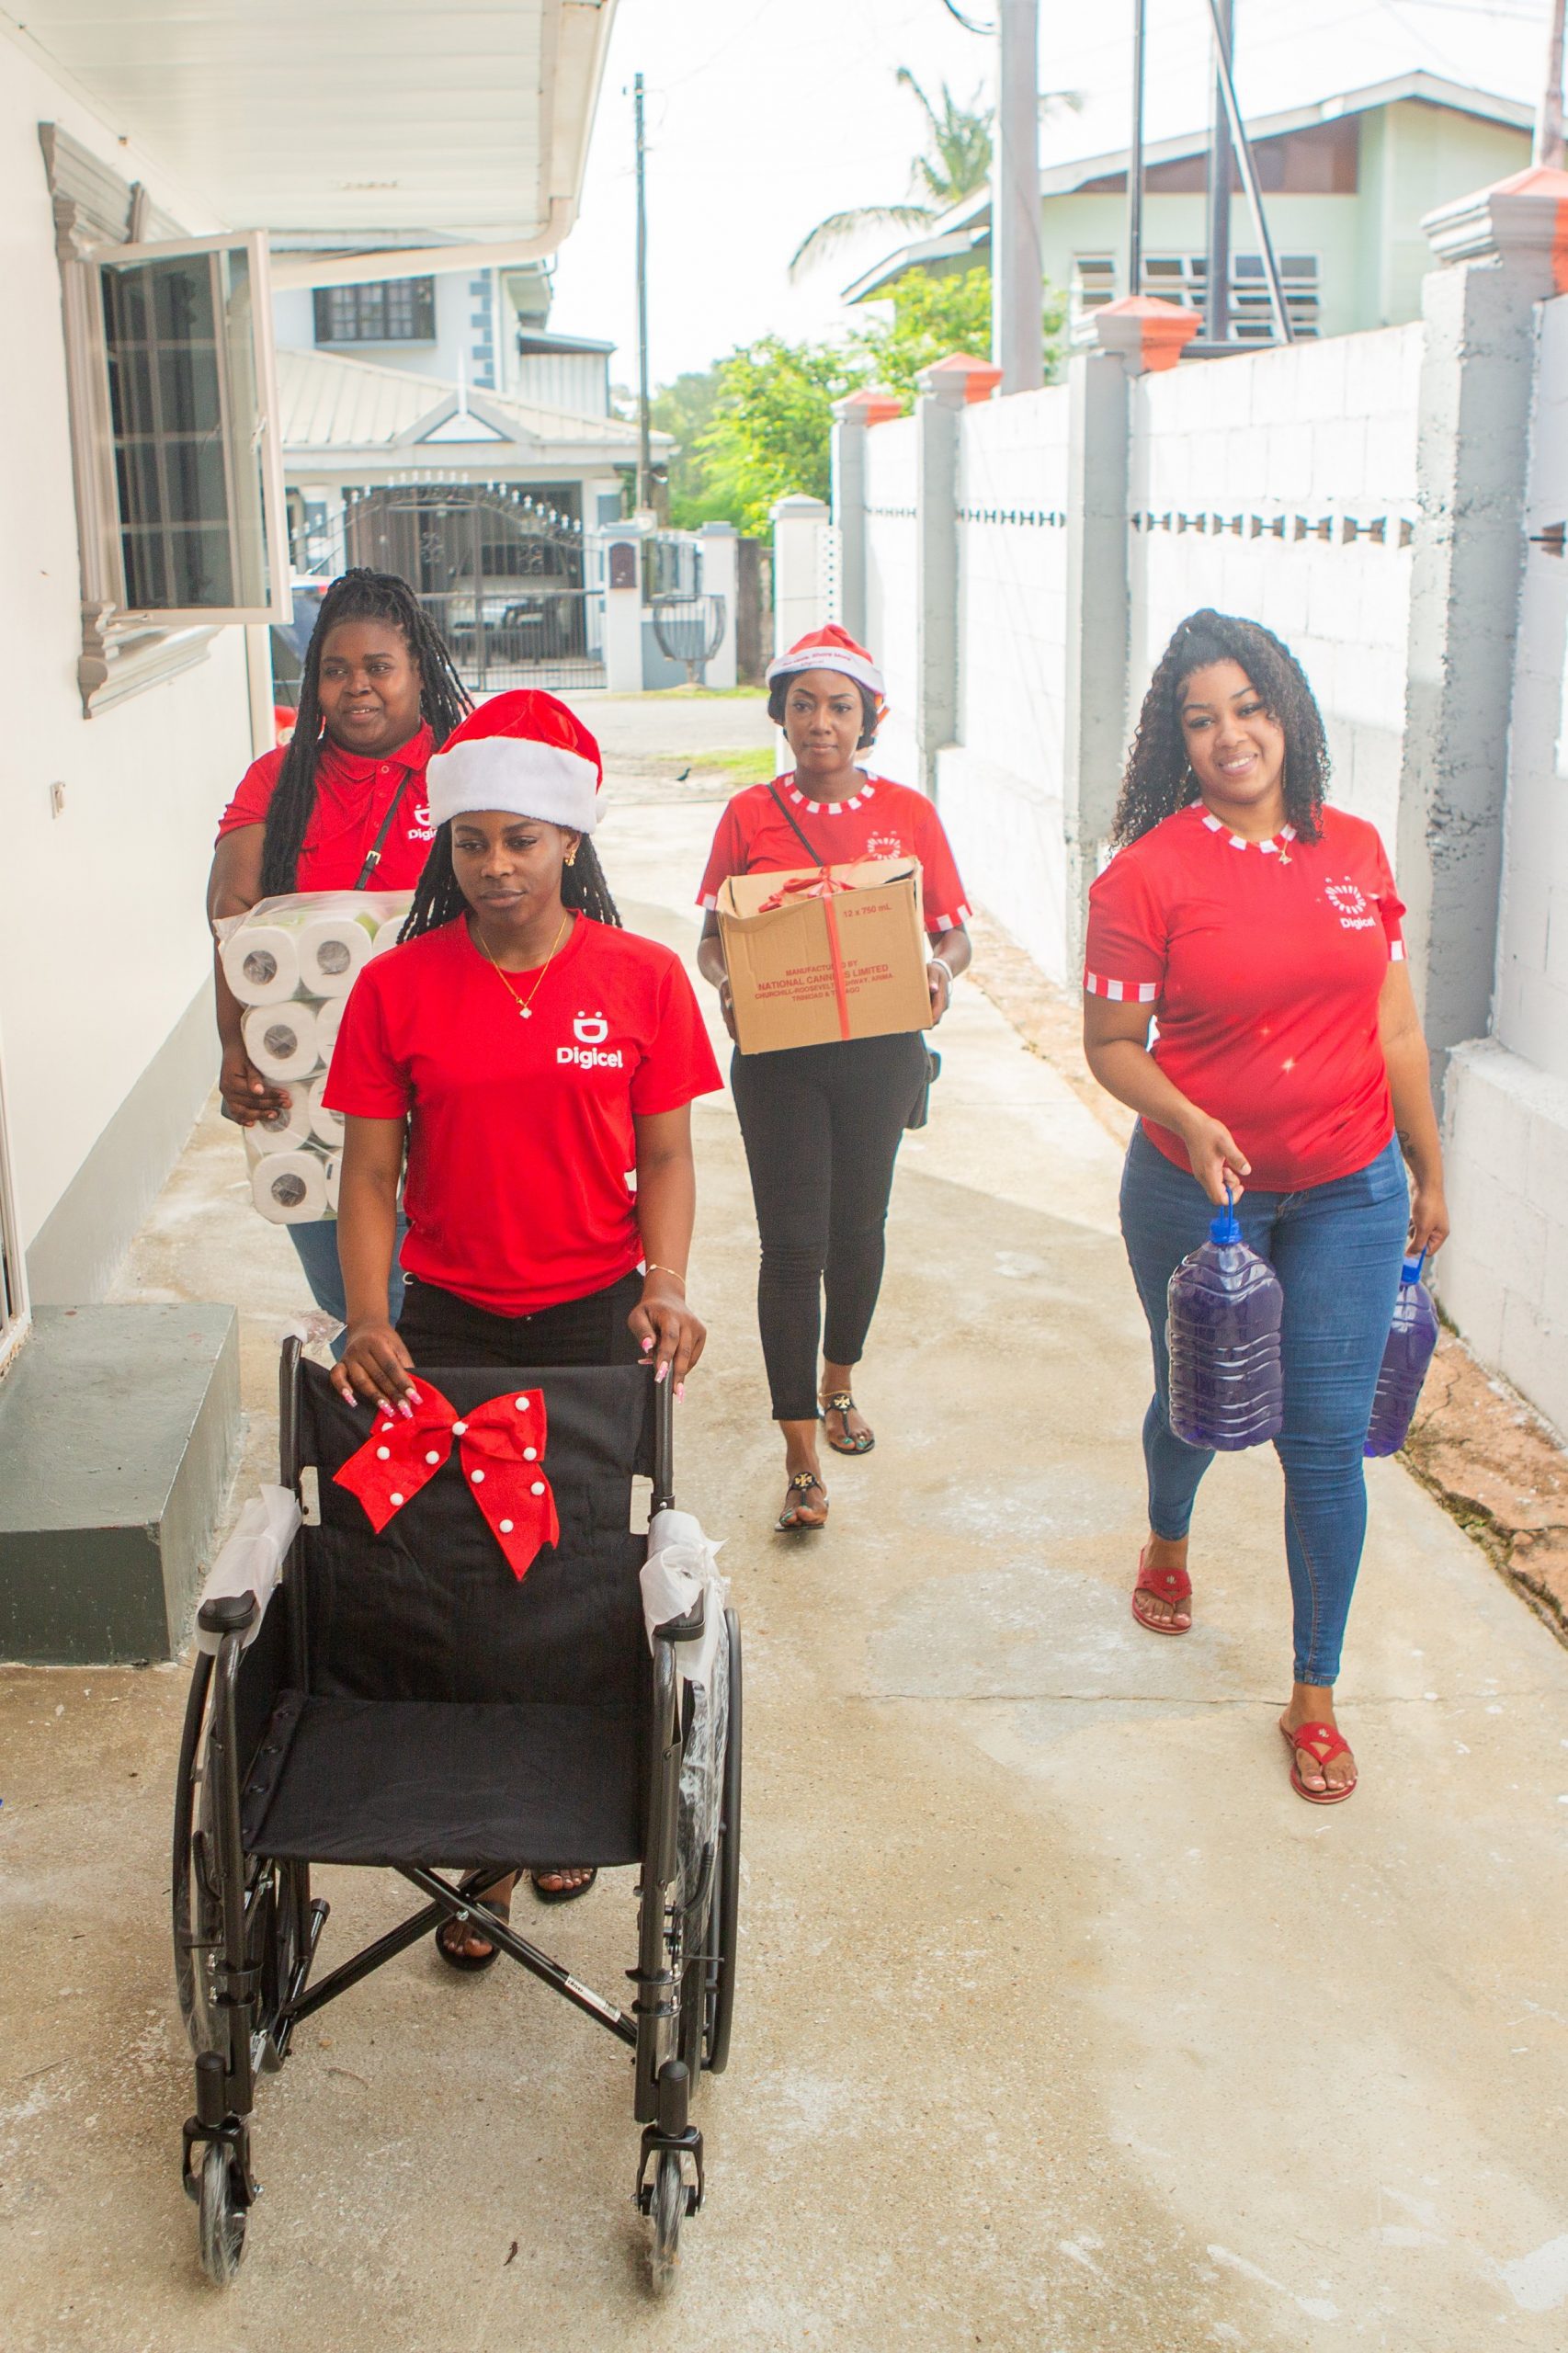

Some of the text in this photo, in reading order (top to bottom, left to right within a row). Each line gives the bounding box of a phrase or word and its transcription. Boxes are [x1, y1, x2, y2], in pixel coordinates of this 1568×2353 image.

[843, 909, 854, 918] 12
[861, 904, 877, 915] 750
[1340, 916, 1376, 929] Digicel
[785, 960, 858, 976] MANUFACTUD BY
[758, 963, 889, 991] NATIONAL CANNS LIMITED
[791, 992, 824, 1002] TRINIDAD
[831, 986, 860, 996] TAGO
[556, 1046, 624, 1070] Digicel
